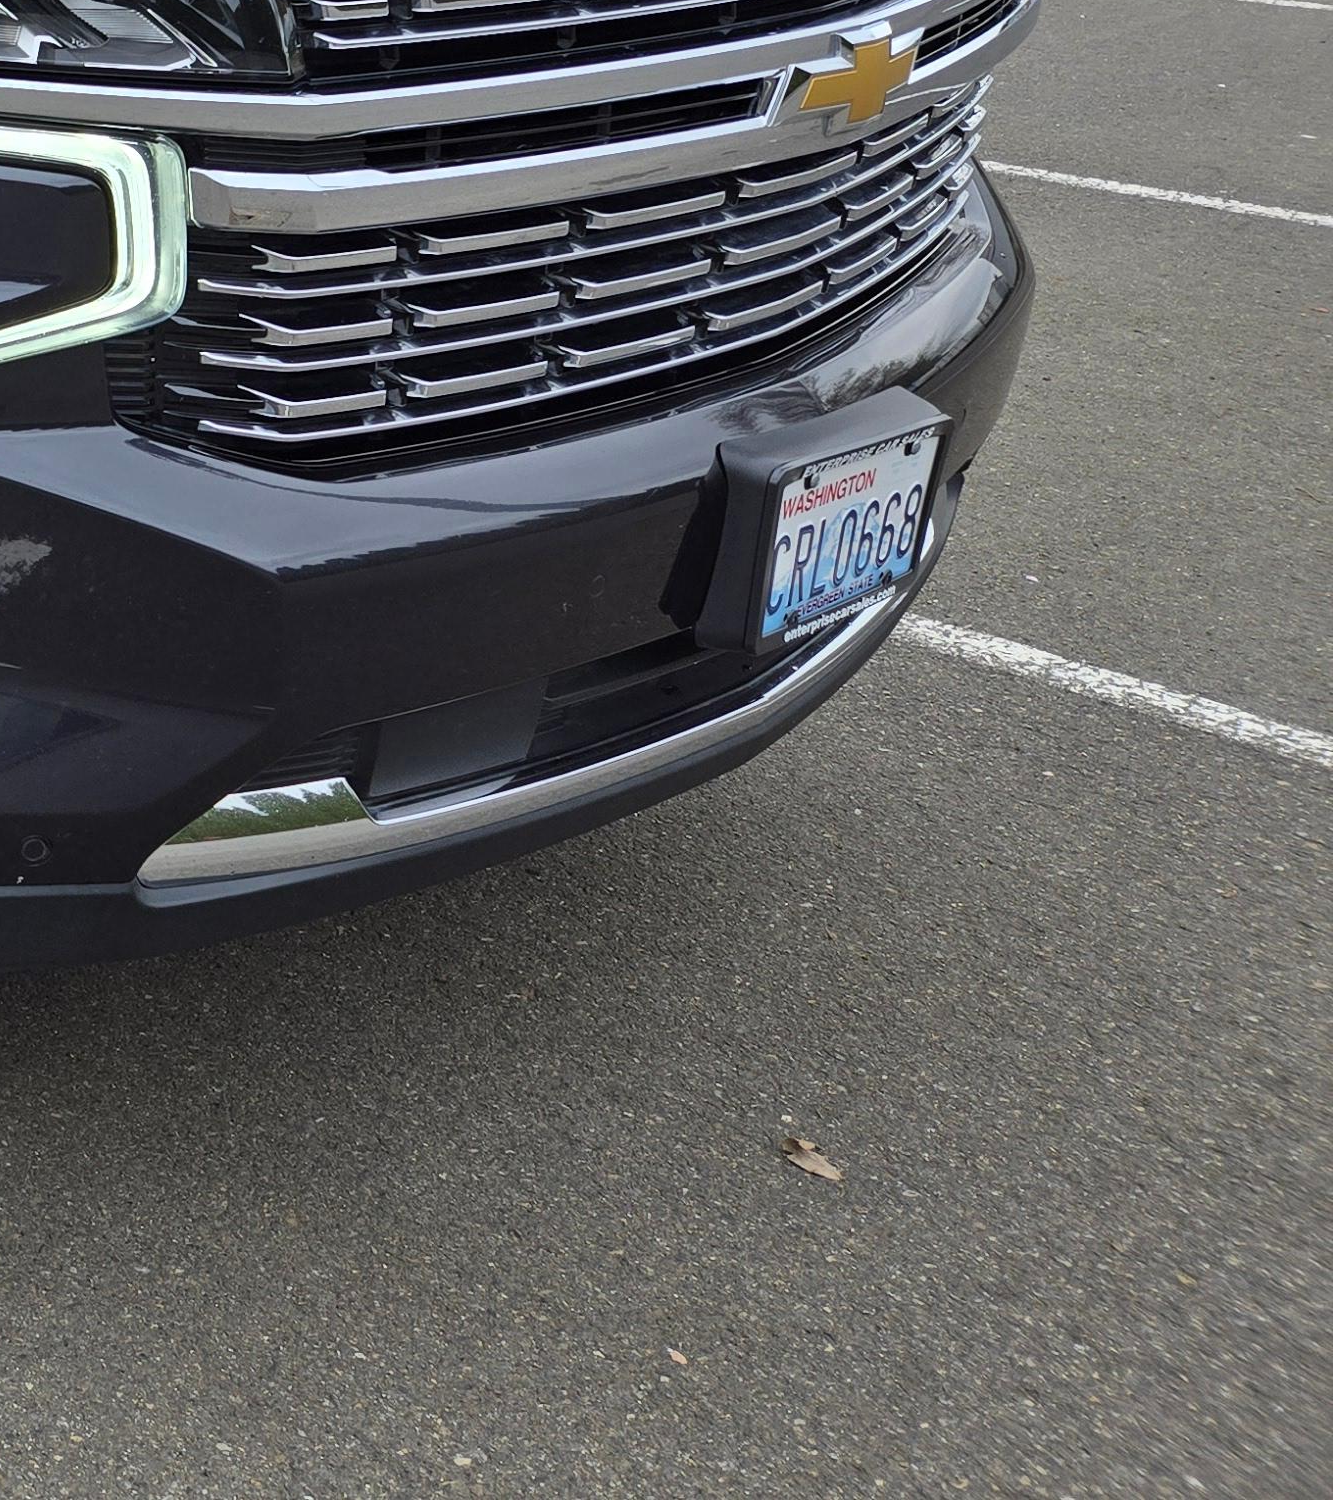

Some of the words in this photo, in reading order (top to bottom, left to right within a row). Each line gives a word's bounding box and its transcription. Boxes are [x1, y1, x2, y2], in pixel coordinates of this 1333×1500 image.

[803, 445, 876, 478] ENTERPRISE
[874, 438, 902, 455] CAR
[901, 426, 935, 445] SALES
[782, 468, 877, 520] WASHINGTON
[766, 484, 923, 616] CRL0668
[784, 585, 896, 643] enterprisecarsales.com
[797, 587, 845, 618] EVERGREEN
[848, 574, 874, 595] STATE
